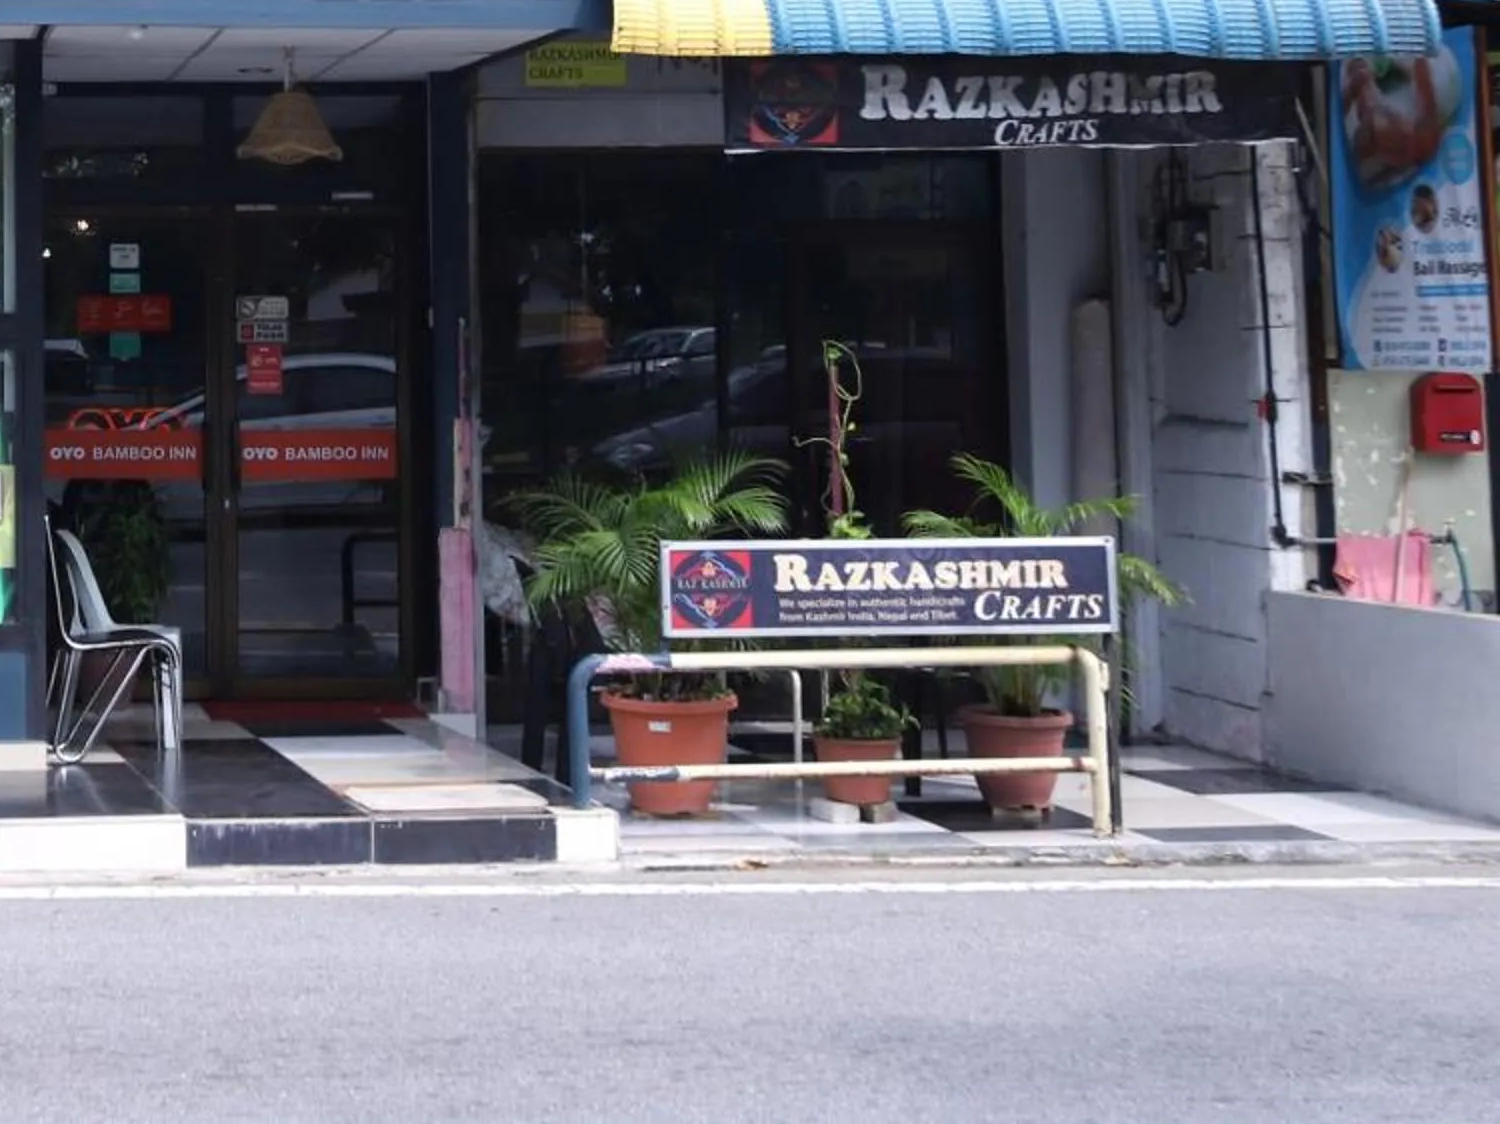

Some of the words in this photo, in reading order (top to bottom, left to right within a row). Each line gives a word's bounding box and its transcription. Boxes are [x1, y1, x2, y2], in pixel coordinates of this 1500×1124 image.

[859, 64, 1223, 121] RAZKASHMIR
[993, 118, 1100, 146] CRAFTS
[50, 446, 86, 461] OYO
[93, 446, 166, 461] BAMBOO
[169, 446, 197, 461] INN
[242, 446, 279, 461] OYO
[285, 446, 358, 462] BAMBOO
[361, 445, 389, 461] INN
[773, 553, 1068, 593] RAZKASHMIR
[973, 590, 1104, 622] CRAFTS
